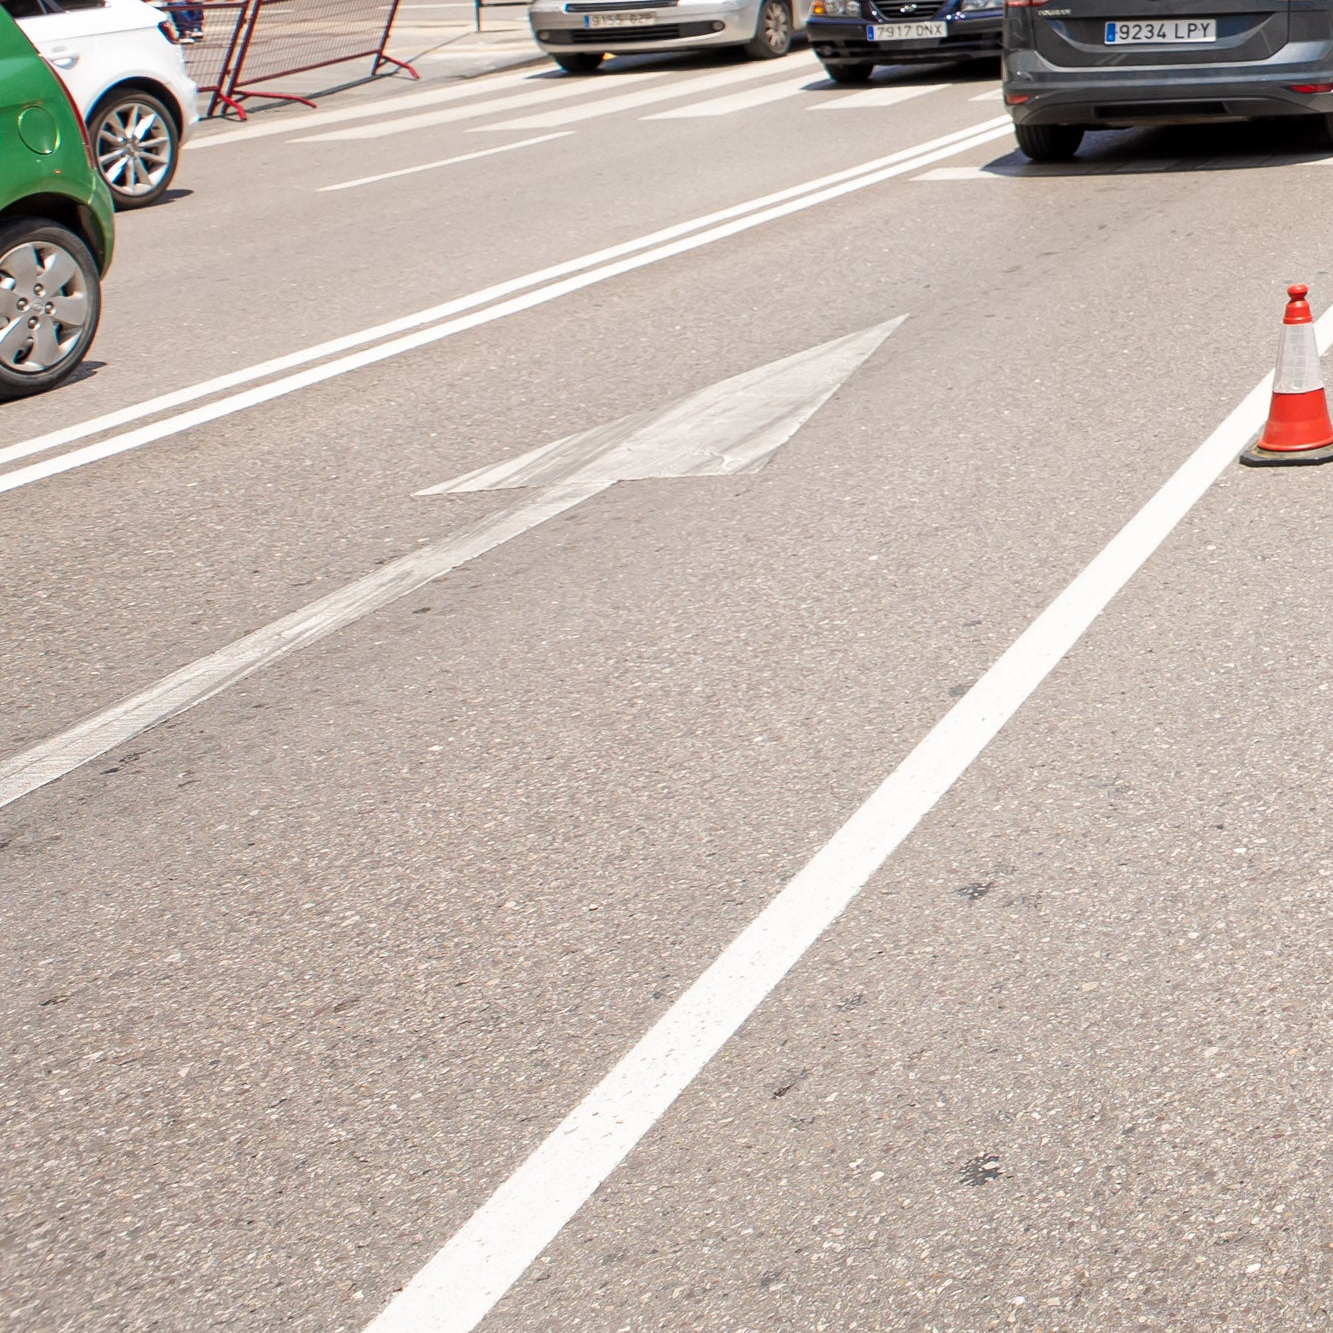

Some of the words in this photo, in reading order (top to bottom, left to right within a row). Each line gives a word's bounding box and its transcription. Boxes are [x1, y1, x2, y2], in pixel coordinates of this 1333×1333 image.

[877, 25, 912, 38] 7917
[1118, 23, 1168, 41] 9234
[1173, 22, 1211, 39] LPY
